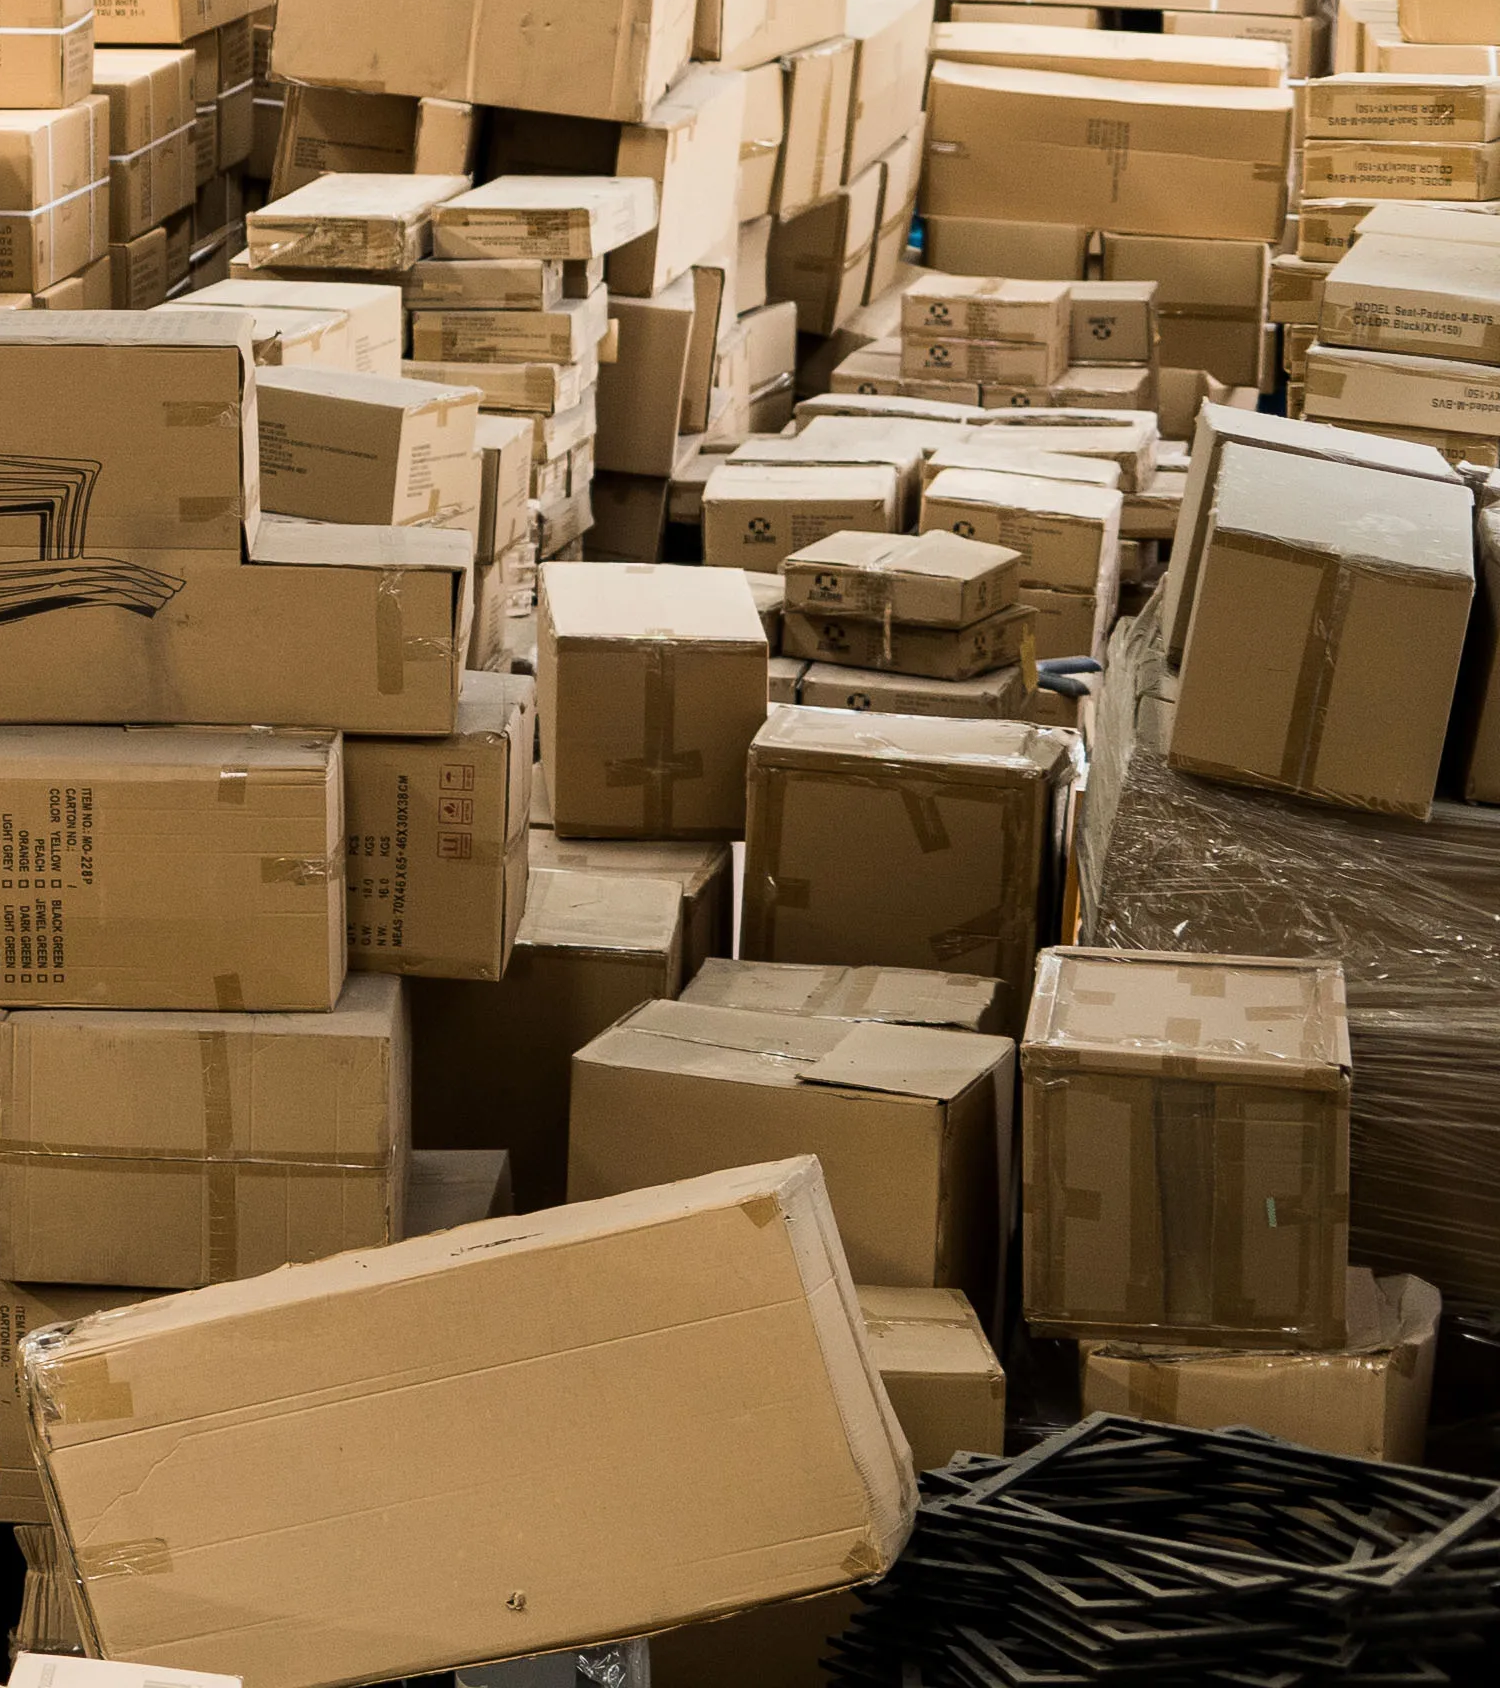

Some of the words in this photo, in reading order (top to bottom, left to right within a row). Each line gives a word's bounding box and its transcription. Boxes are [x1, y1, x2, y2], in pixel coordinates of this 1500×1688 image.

[50, 788, 60, 823] COLOR
[66, 788, 76, 828] CARTON
[82, 788, 92, 811] ITEM
[3, 814, 12, 841] LIGHT
[3, 843, 13, 872] GREY
[19, 830, 29, 872] ORANGE
[34, 839, 44, 872] PEACH
[51, 831, 61, 872] YELLOW
[365, 835, 375, 857] KGS
[380, 836, 390, 857] KGS
[4, 905, 14, 932] LIGHT
[20, 906, 30, 932] DARK
[36, 899, 46, 932] JEWEL
[52, 900, 62, 933] BLACK
[5, 936, 15, 968] GREEN
[21, 935, 31, 969] GREEN
[37, 935, 47, 968] GREEN
[53, 936, 63, 968] GREEN
